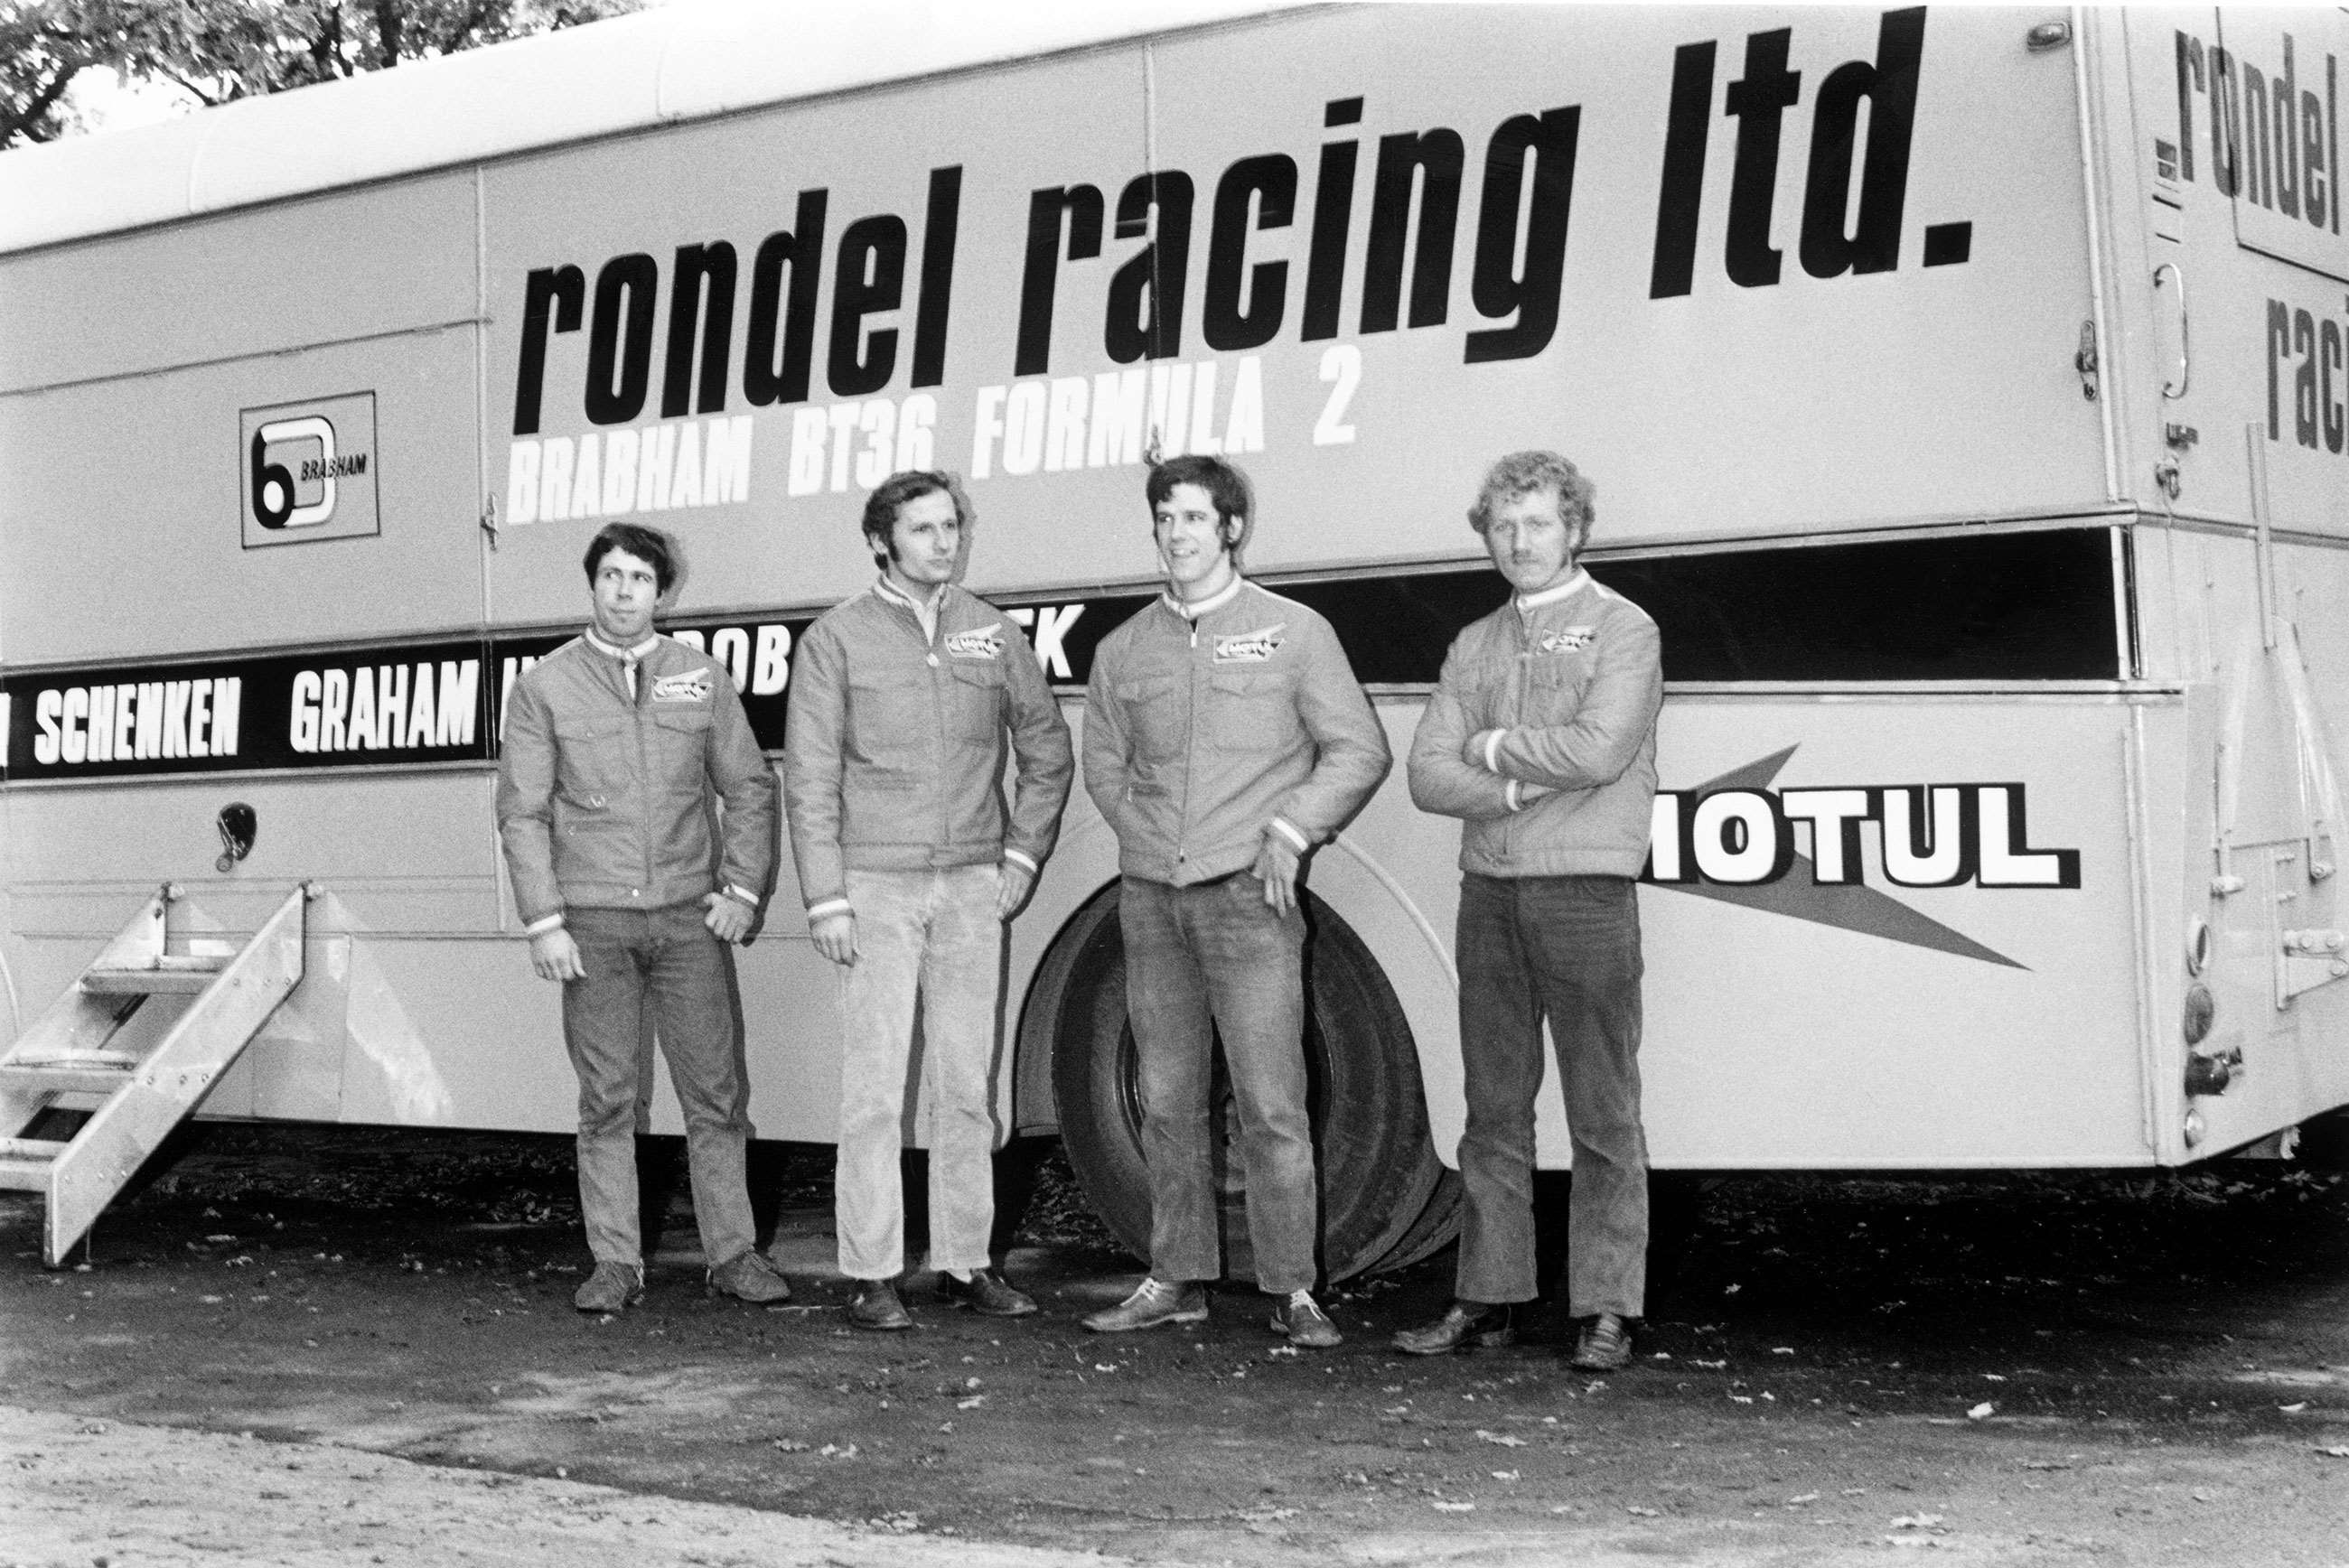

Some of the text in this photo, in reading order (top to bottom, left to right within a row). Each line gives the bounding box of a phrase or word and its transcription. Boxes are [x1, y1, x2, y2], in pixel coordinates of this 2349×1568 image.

[2176, 29, 2340, 236] rondel
[513, 5, 1972, 436] rondel racing ltd.
[506, 343, 1362, 526] BRABHAM BT36 FORMULA 2
[2267, 294, 2349, 457] rac
[300, 453, 367, 481] BRABHAM
[34, 677, 241, 765] SCHENKEN
[289, 659, 479, 753] GRAHAM
